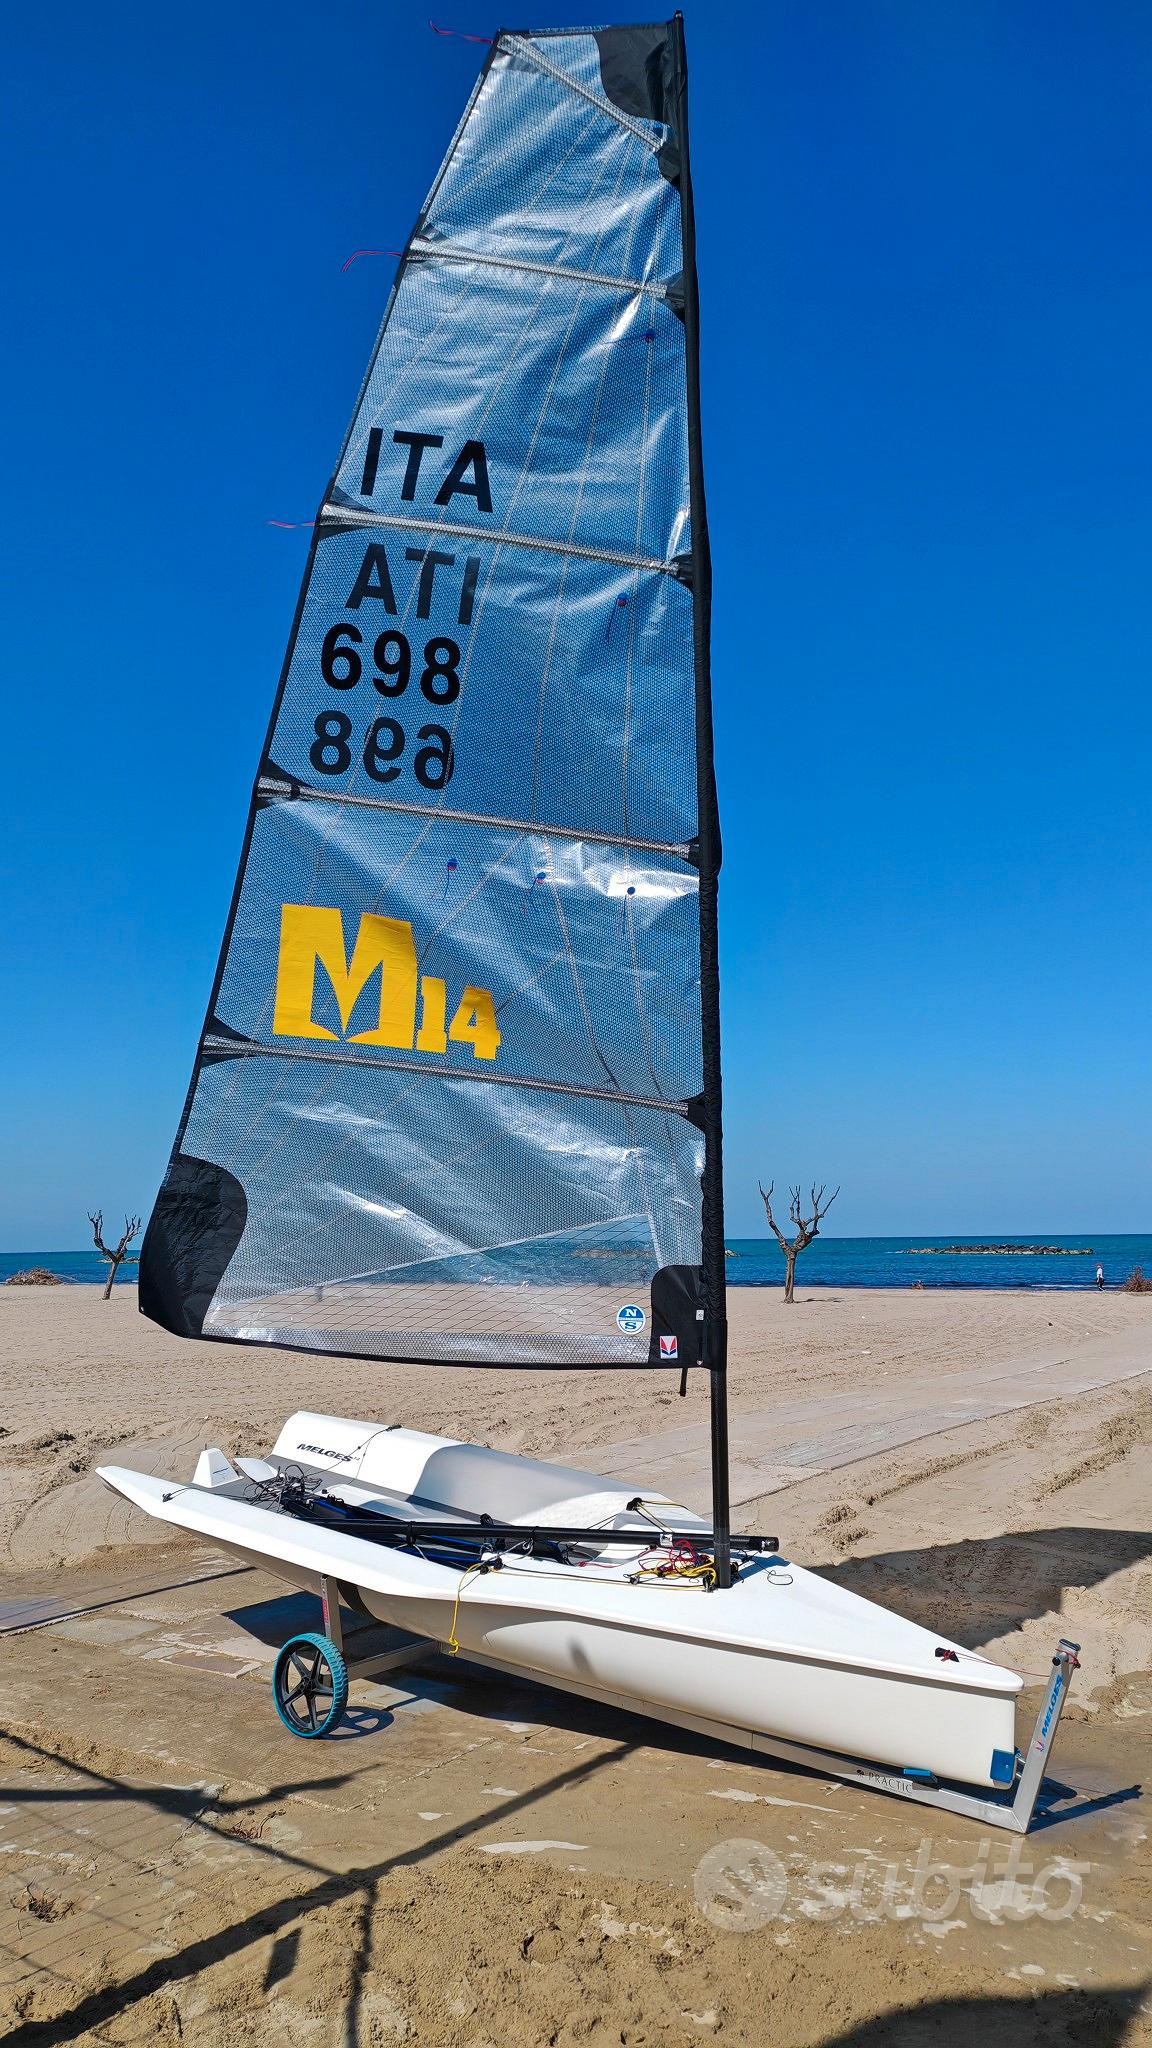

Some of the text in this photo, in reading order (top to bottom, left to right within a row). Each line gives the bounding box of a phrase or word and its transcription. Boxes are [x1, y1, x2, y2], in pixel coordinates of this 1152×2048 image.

[360, 428, 493, 513] ITA
[321, 623, 461, 705] 698
[625, 1309, 637, 1317] N
[625, 1321, 637, 1330] S
[296, 1443, 353, 1462] MELGES
